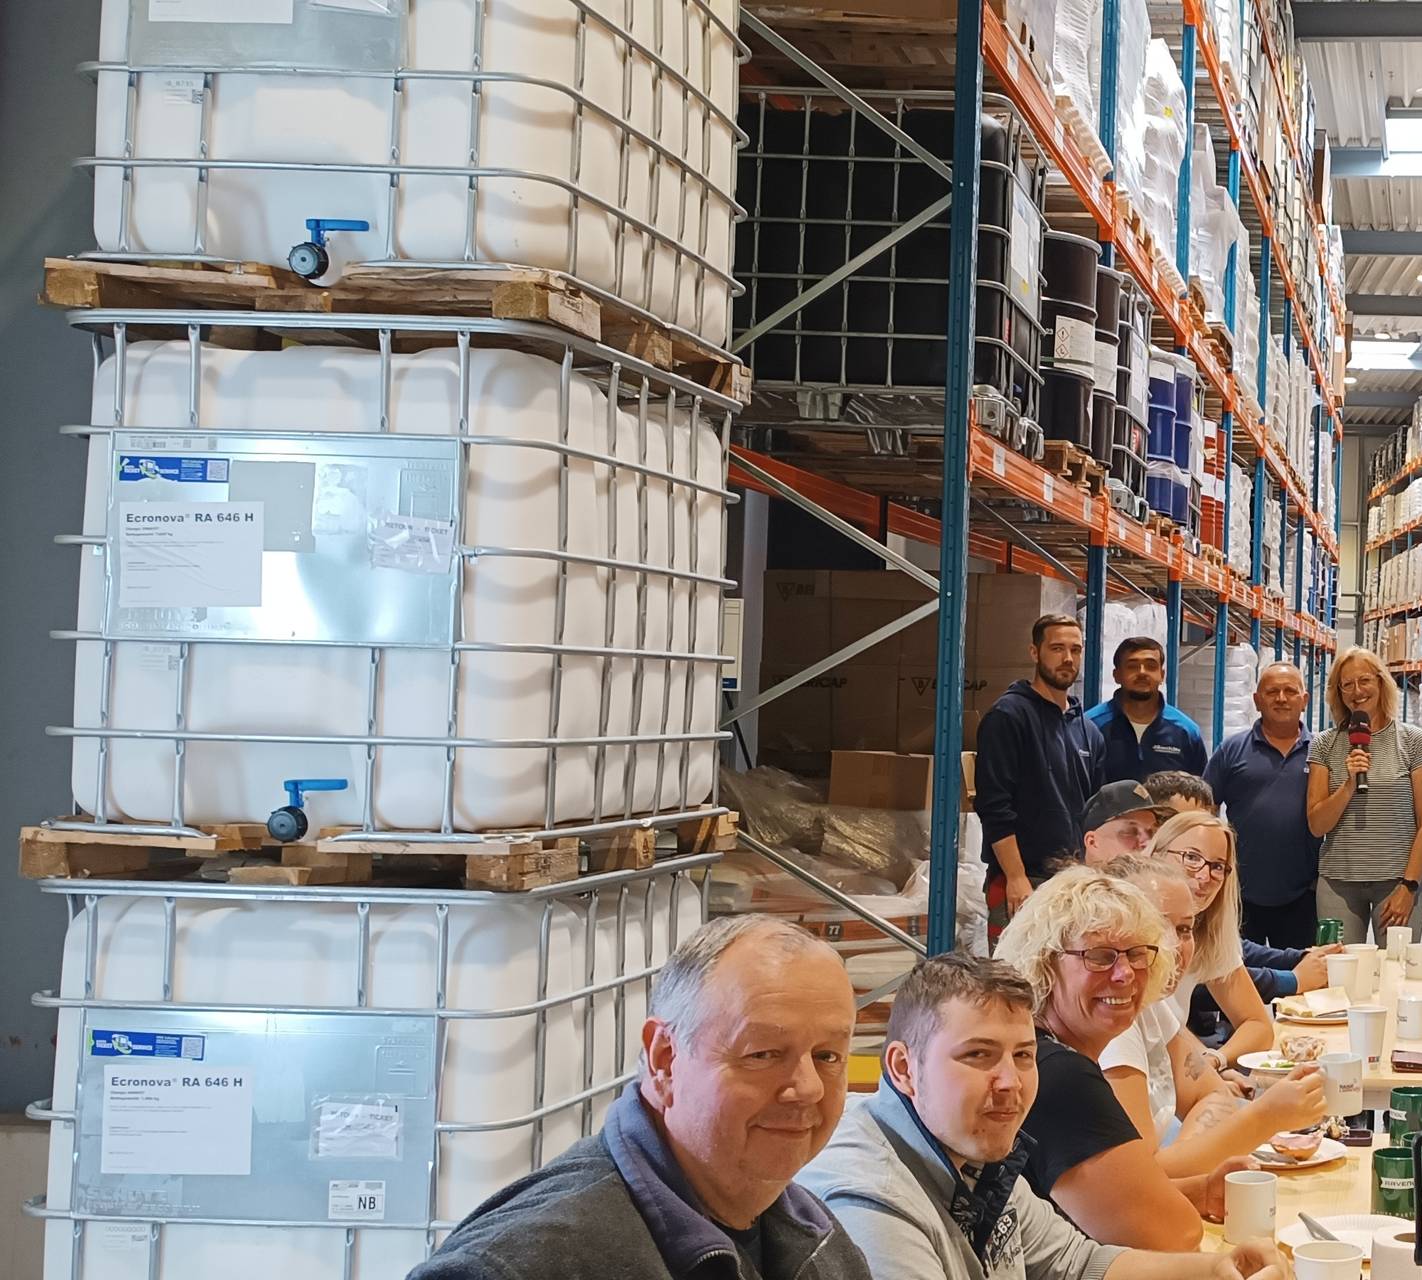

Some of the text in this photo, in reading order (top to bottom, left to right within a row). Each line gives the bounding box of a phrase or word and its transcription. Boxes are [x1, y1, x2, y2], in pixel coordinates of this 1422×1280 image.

[194, 512, 213, 522] RA
[216, 512, 240, 523] 646
[245, 512, 254, 522] H
[182, 1077, 200, 1087] RA
[204, 1077, 229, 1088] 646
[233, 1077, 243, 1087] H
[358, 1196, 376, 1210] NB
